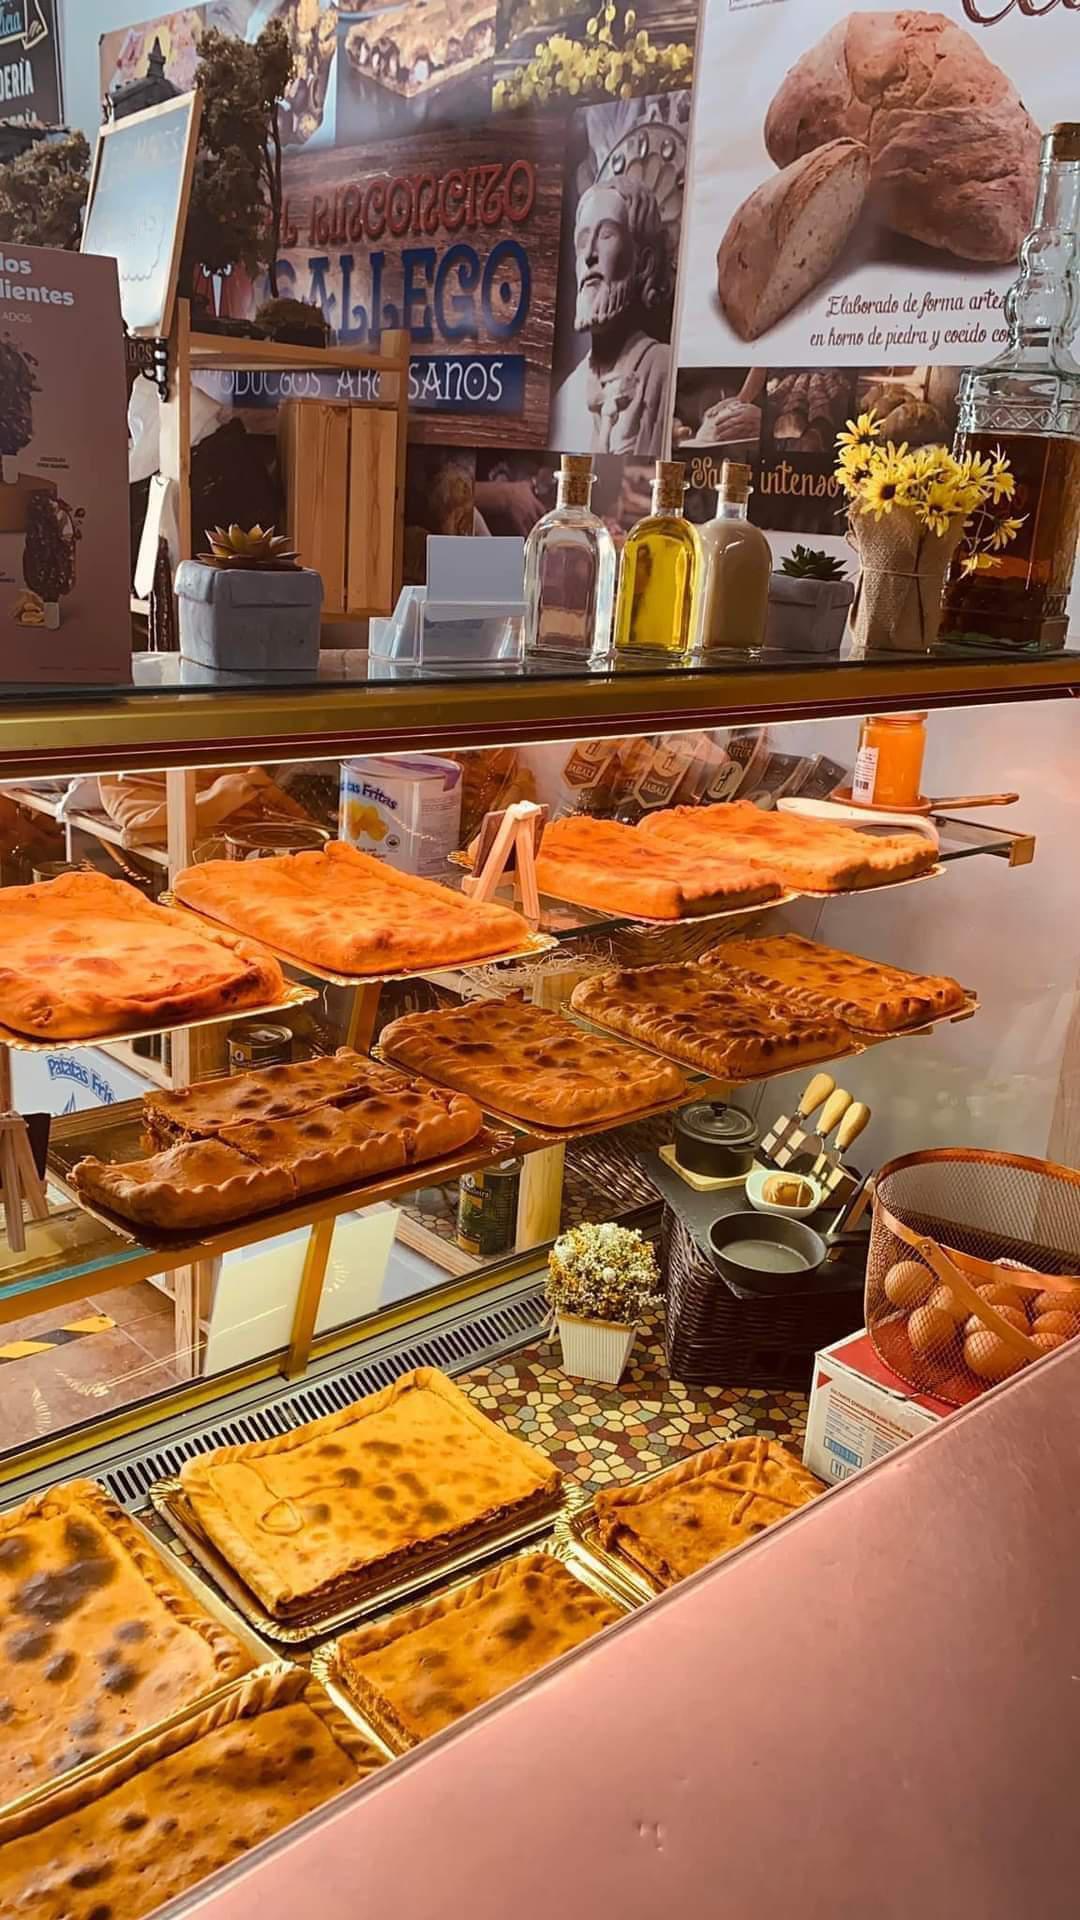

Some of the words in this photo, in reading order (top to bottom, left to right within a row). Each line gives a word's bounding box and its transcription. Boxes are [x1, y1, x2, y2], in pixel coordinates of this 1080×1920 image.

[826, 293, 899, 317] Elaborado
[902, 292, 919, 313] de
[917, 291, 964, 319] forma
[809, 332, 825, 347] en
[827, 327, 864, 346] horno
[867, 326, 883, 345] de
[884, 324, 928, 352] piedra
[928, 331, 941, 351] y
[944, 322, 988, 345] cocido
[760, 459, 842, 498] intenso
[362, 782, 399, 811] Fritas
[46, 1057, 89, 1086] Patatas
